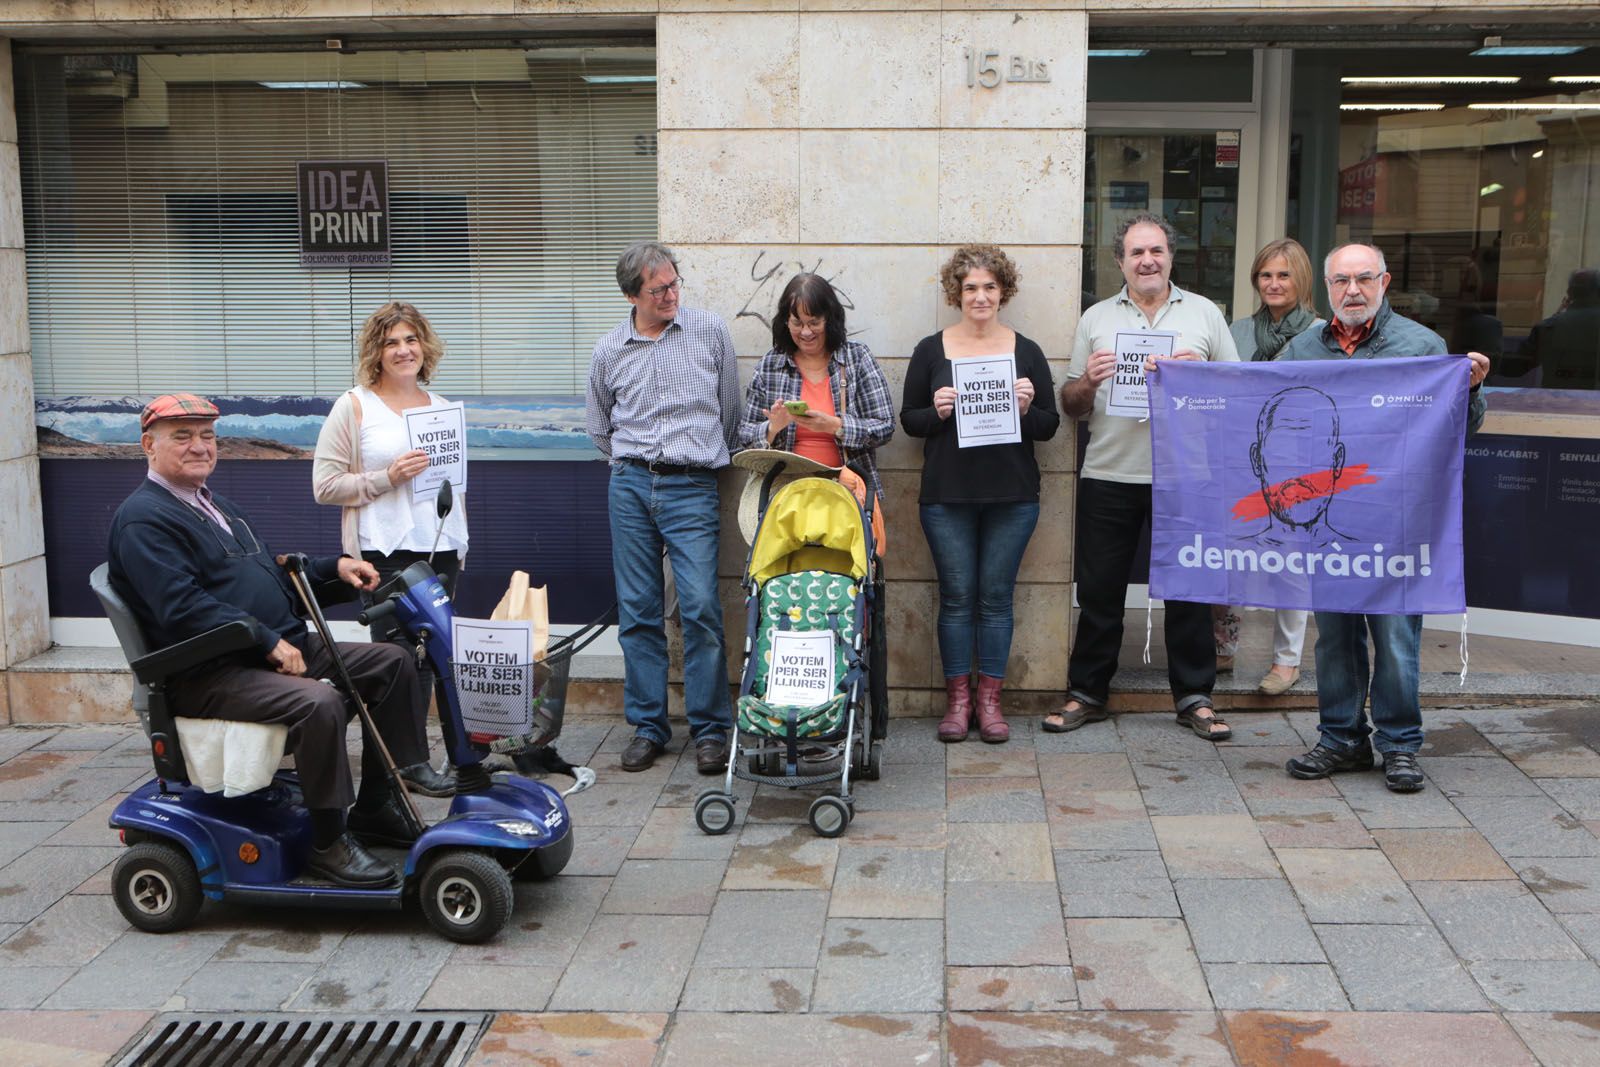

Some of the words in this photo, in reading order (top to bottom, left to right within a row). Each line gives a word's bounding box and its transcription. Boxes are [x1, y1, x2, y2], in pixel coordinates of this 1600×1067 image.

[964, 47, 1002, 89] 15
[307, 170, 380, 210] IDEA
[309, 211, 383, 243] PRINT
[303, 254, 345, 264] SOLUCIONS
[1122, 352, 1151, 363] VOT
[1116, 363, 1140, 374] PER
[963, 379, 1006, 392] VOTEM
[960, 393, 984, 404] PER
[986, 391, 1011, 402] SER
[962, 402, 1011, 416] LLIURES
[417, 429, 456, 443] VOTEM
[439, 440, 460, 454] SER
[428, 453, 460, 467] IURES
[1496, 449, 1539, 460] ACABATS
[1178, 534, 1432, 578] democràcia!
[465, 650, 518, 665] VOTEM
[781, 655, 824, 666] VOTEM
[460, 664, 487, 679] PER
[492, 667, 523, 681] SER
[775, 667, 799, 677] PER
[803, 667, 827, 678] SER
[461, 679, 522, 696] LLIURES
[775, 677, 826, 690] LLIURES
